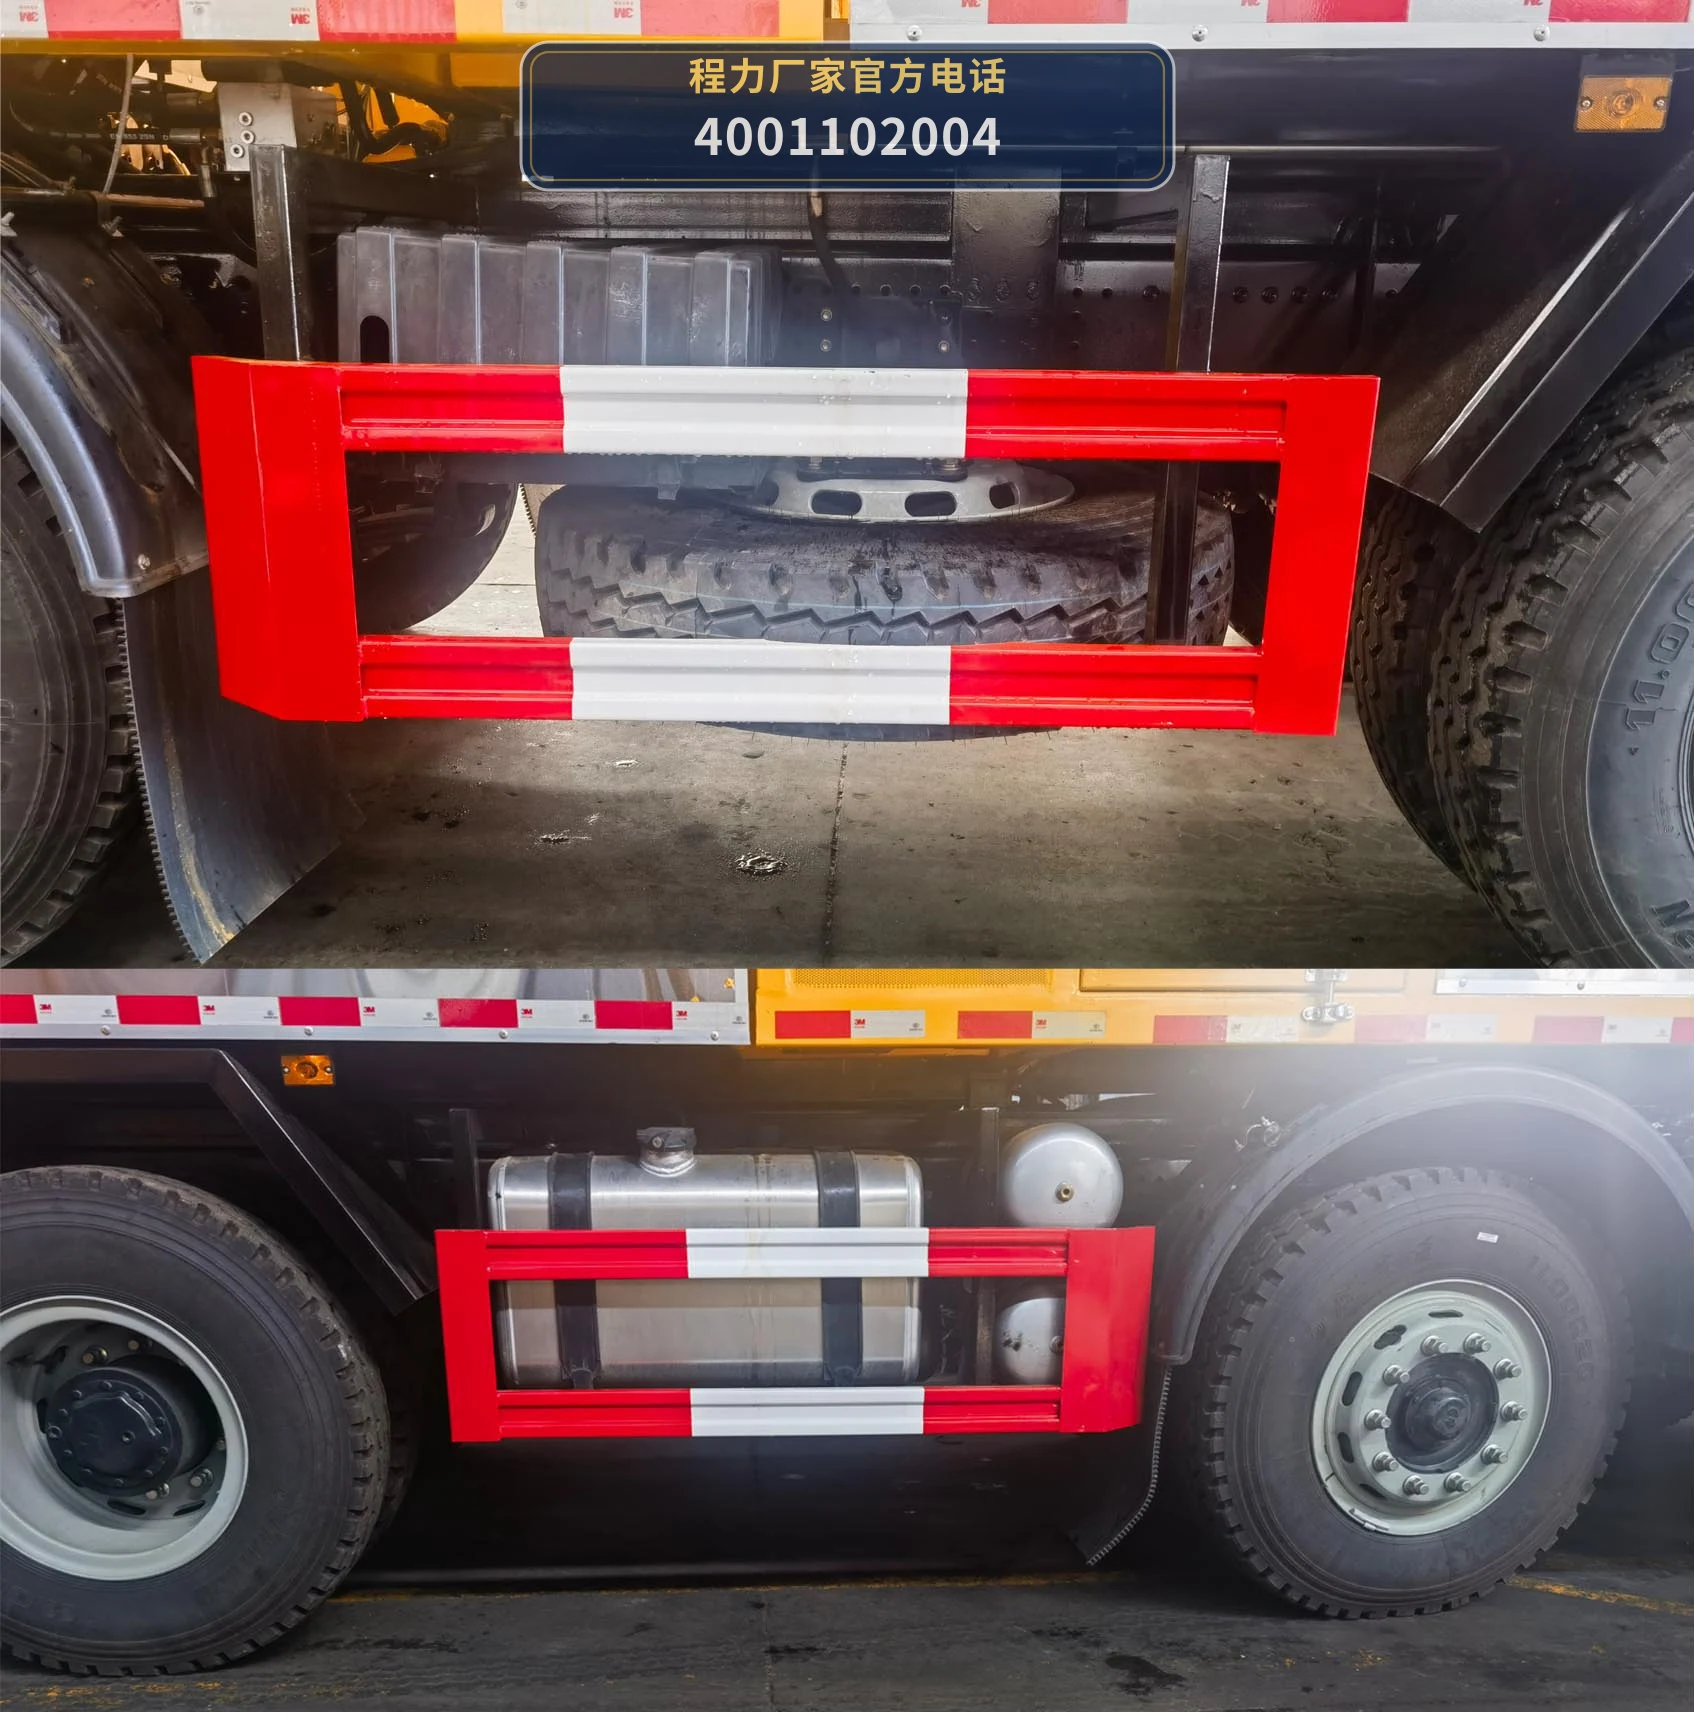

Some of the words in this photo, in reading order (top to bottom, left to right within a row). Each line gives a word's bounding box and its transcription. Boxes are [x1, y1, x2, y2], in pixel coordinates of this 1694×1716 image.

[20, 11, 39, 22] 3M
[614, 7, 633, 18] 3M
[290, 13, 310, 24] 3M
